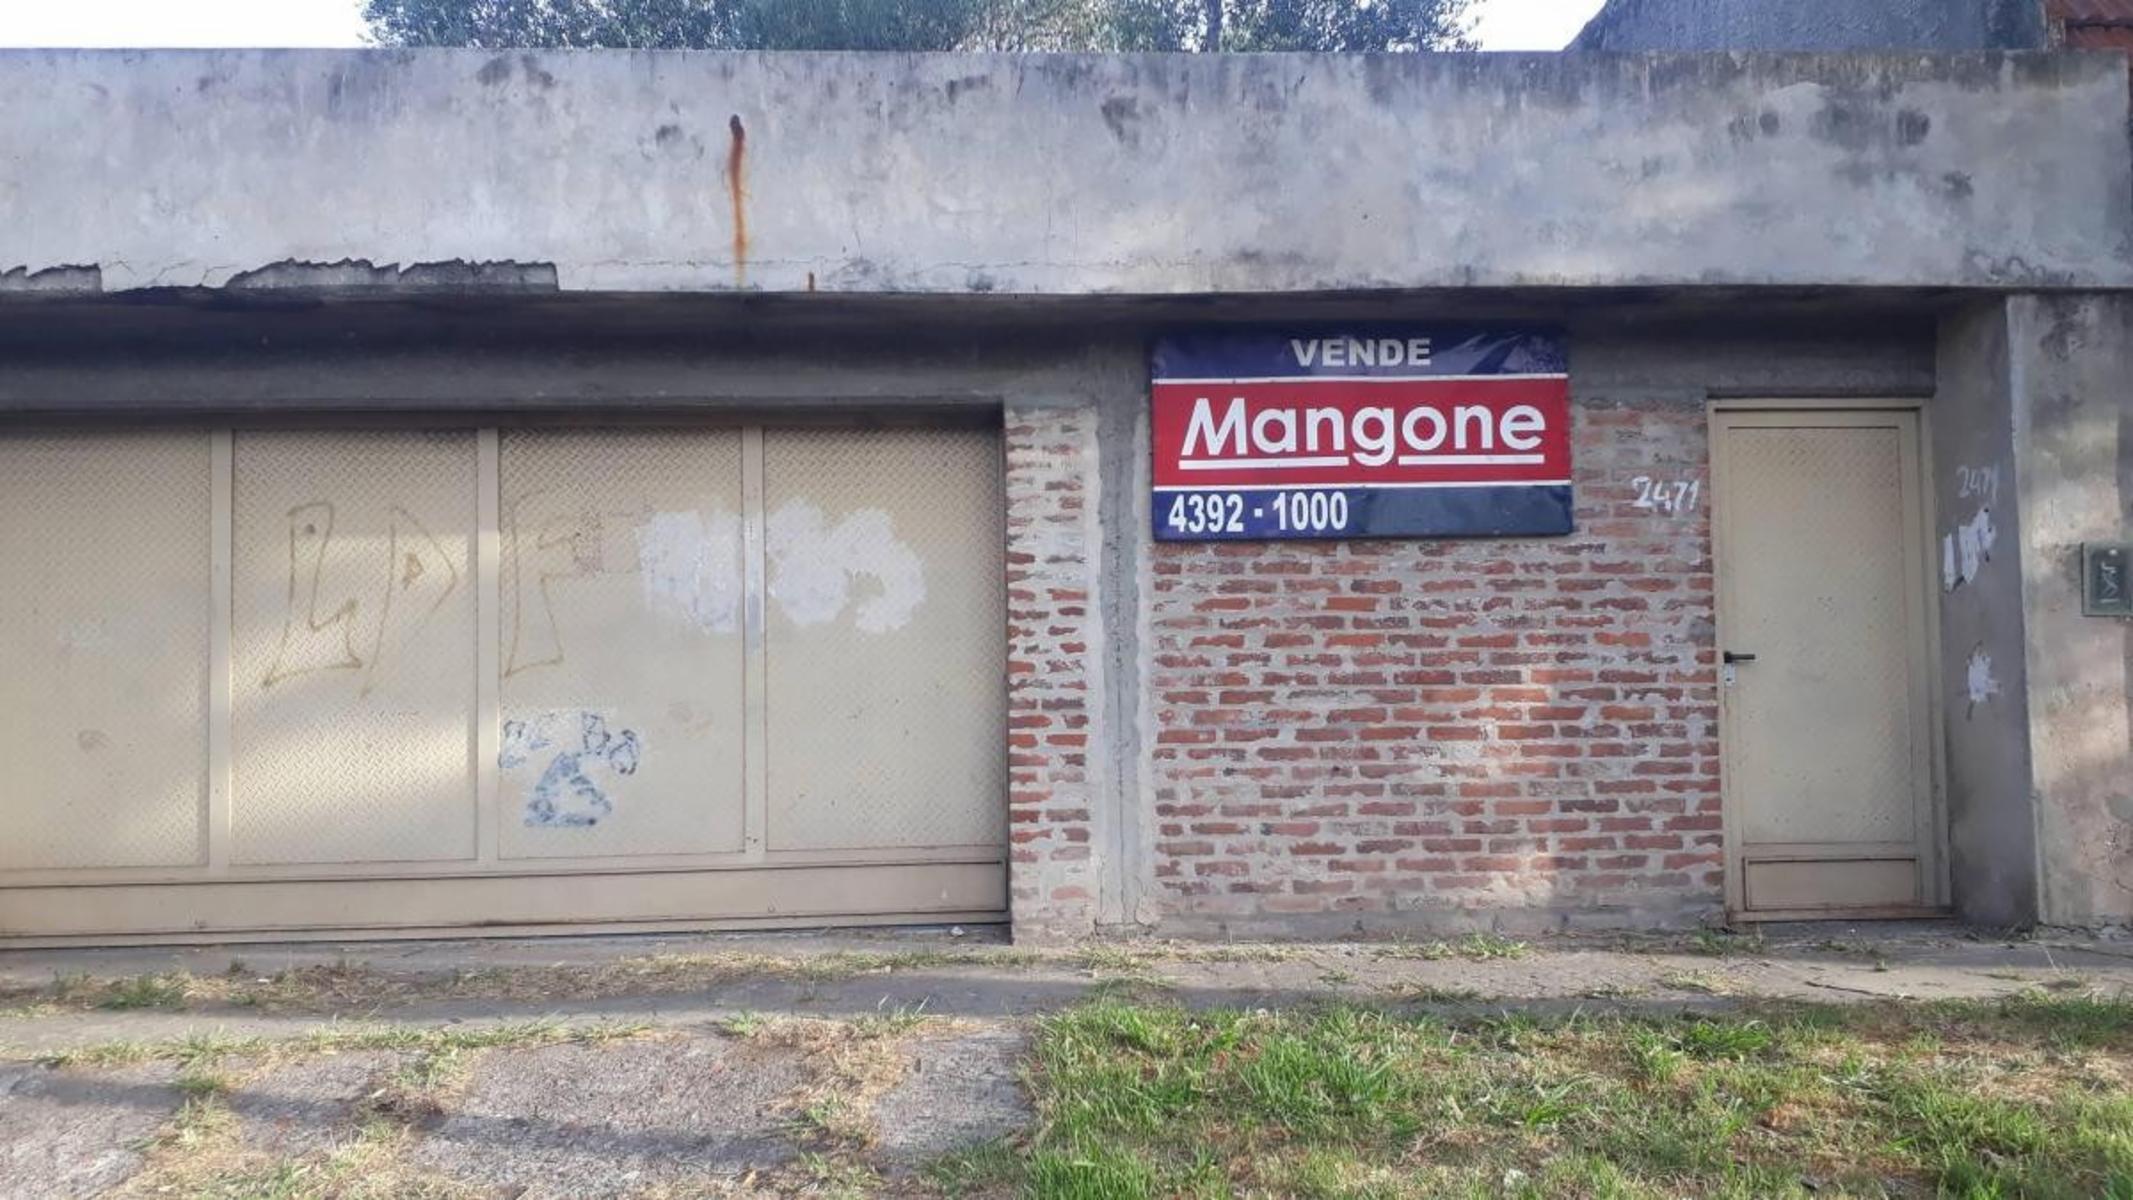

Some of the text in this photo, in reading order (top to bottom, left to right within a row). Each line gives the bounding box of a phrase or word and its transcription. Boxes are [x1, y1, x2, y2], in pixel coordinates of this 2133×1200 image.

[1290, 338, 1432, 367] VENDE
[1180, 396, 1546, 467] Mangone
[1168, 493, 1244, 532] 4392
[1272, 491, 1348, 531] 1000
[1630, 475, 1700, 512] 2471
